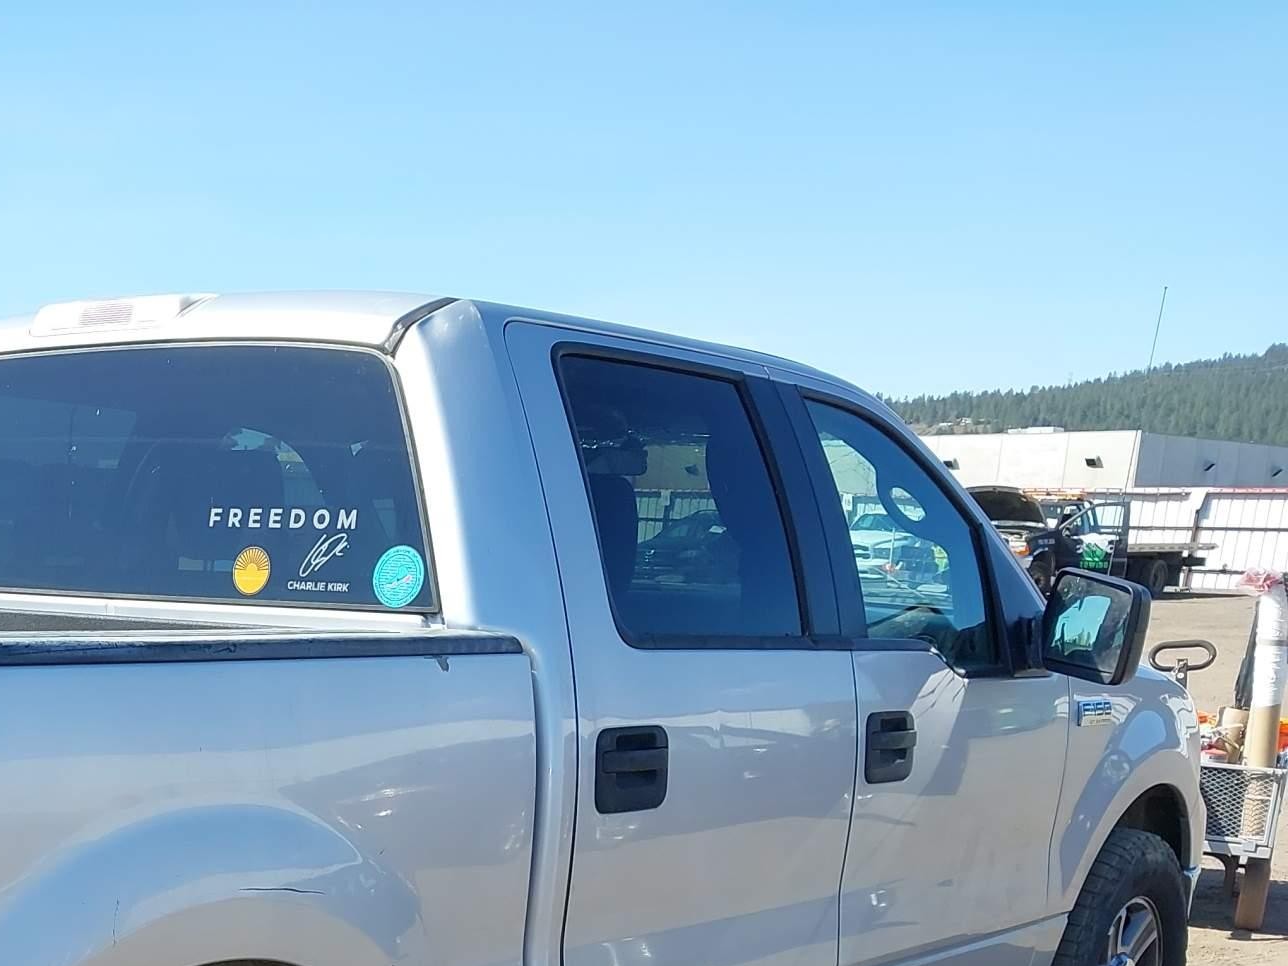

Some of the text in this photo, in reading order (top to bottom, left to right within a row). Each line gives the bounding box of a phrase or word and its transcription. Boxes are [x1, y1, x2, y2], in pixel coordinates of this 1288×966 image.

[208, 507, 358, 530] FREEDOM
[287, 580, 350, 593] CHARLIE KIRK
